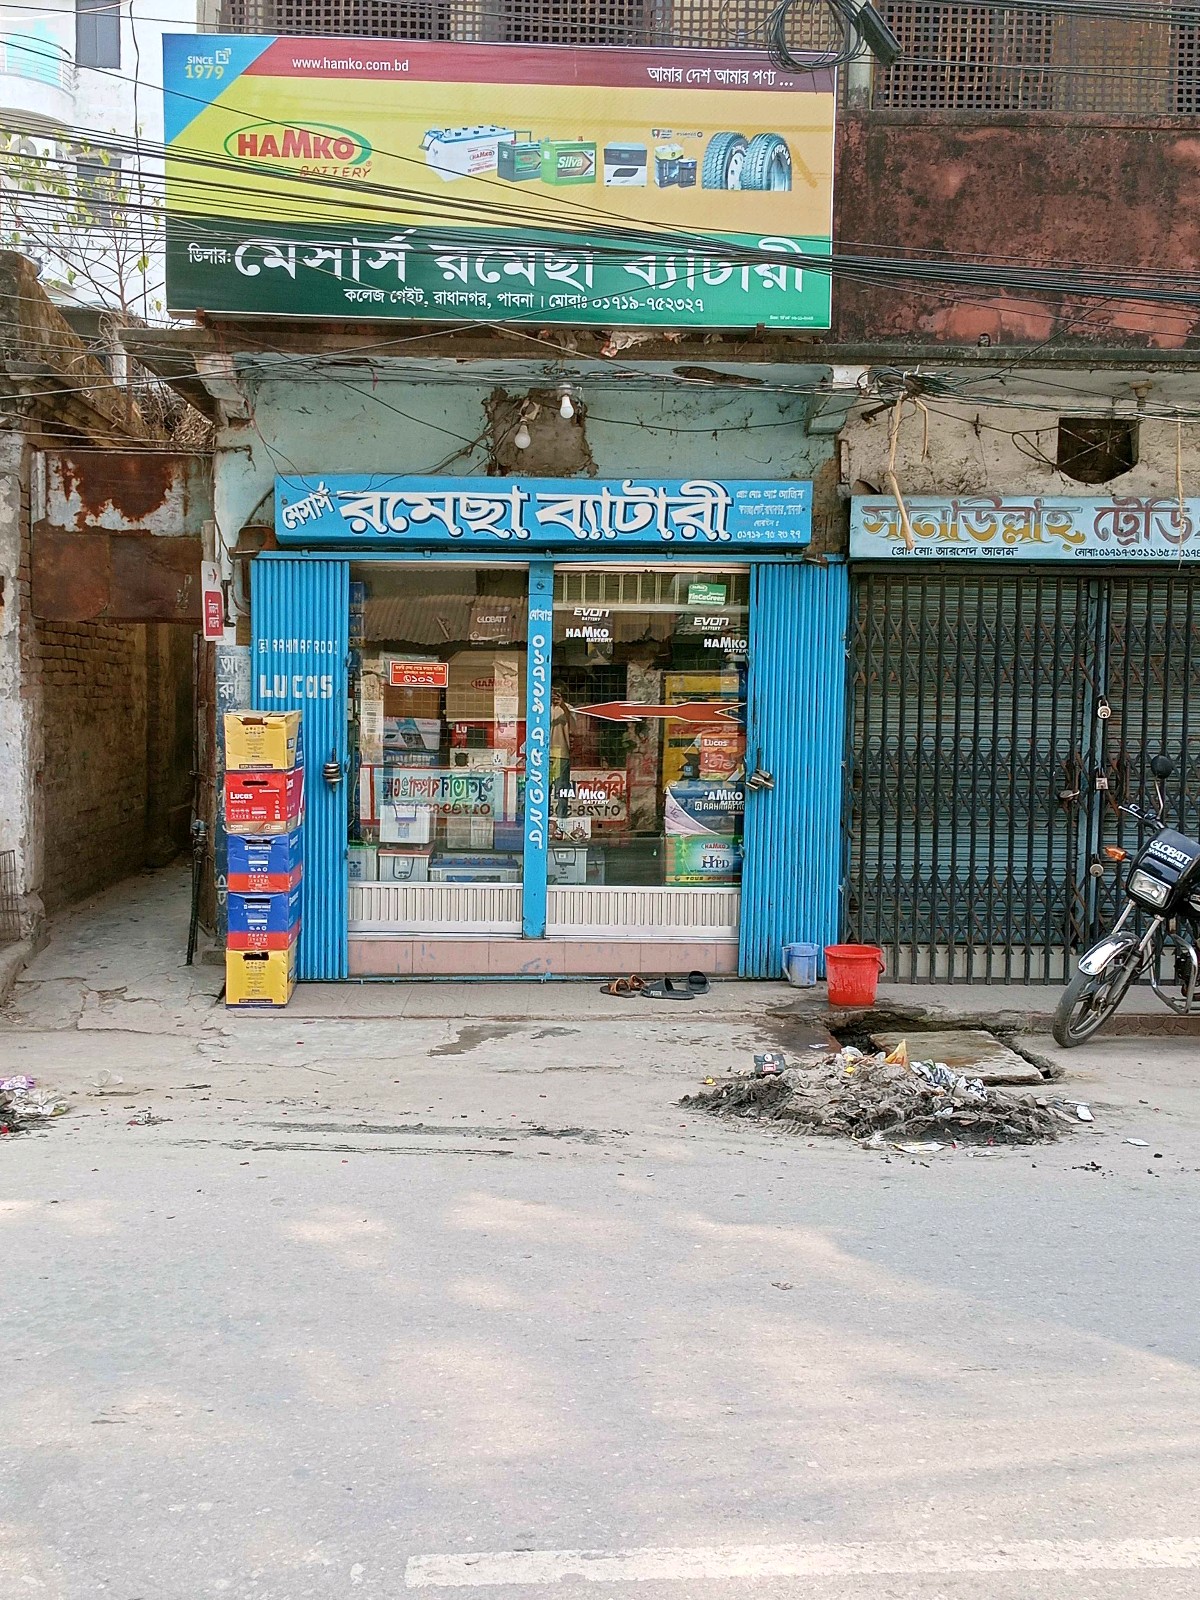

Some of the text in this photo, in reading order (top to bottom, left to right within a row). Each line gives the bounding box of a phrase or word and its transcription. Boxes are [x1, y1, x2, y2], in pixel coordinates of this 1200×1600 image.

[187, 55, 214, 65] SINCE
[292, 57, 409, 72] www.hamko.com.bd
[185, 65, 225, 79] 1979
[647, 66, 683, 83] আমার
[686, 68, 710, 83] দেশ
[714, 68, 749, 84] আমার
[752, 70, 776, 85] পণ্য
[237, 129, 355, 161] HAMKO
[556, 156, 584, 169] Silva
[300, 165, 372, 178] BATTERY
[234, 229, 416, 282] মেসার্স
[429, 240, 600, 291] রমেছা
[344, 288, 385, 303] কলেজ
[390, 289, 429, 307] গেইট,
[433, 290, 492, 309] রাধানগর,
[496, 292, 534, 308] পাবনা
[592, 296, 704, 312] ০১৭১৯-৭৫২৩২৭
[281, 480, 735, 542] মেসার্স রমেছা ব্যাটারী
[573, 607, 610, 617] EVON
[476, 615, 508, 624] GLOBATT
[693, 617, 729, 626] EVON
[565, 626, 609, 638] HAMKO
[703, 637, 748, 649] HAMKO
[703, 738, 729, 747] Lucas
[229, 791, 253, 800] Lucas
[1149, 839, 1193, 865] GLOBATT
